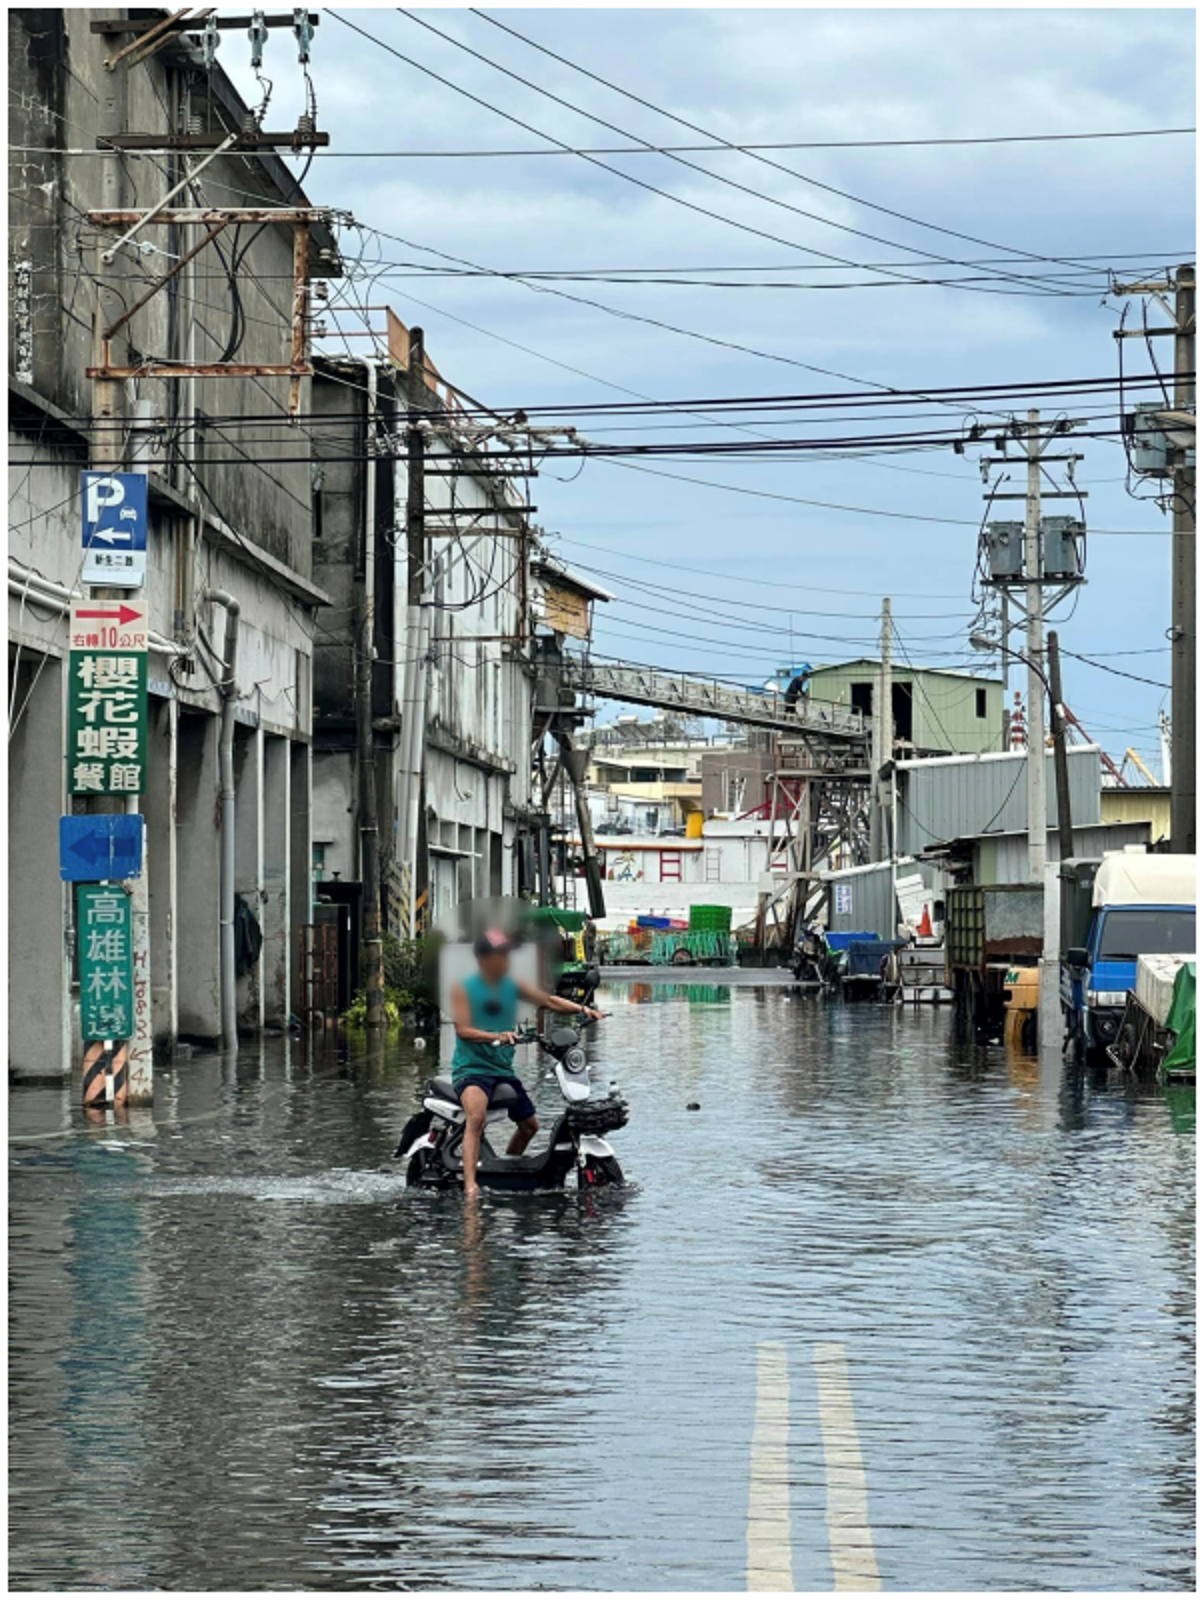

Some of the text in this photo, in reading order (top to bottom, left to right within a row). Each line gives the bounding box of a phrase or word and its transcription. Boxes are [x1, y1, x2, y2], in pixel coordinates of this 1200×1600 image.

[86, 476, 125, 523] P
[73, 626, 145, 648] 右轉10公尺
[77, 656, 139, 760] 櫻花蝦
[73, 763, 141, 791] 餐館
